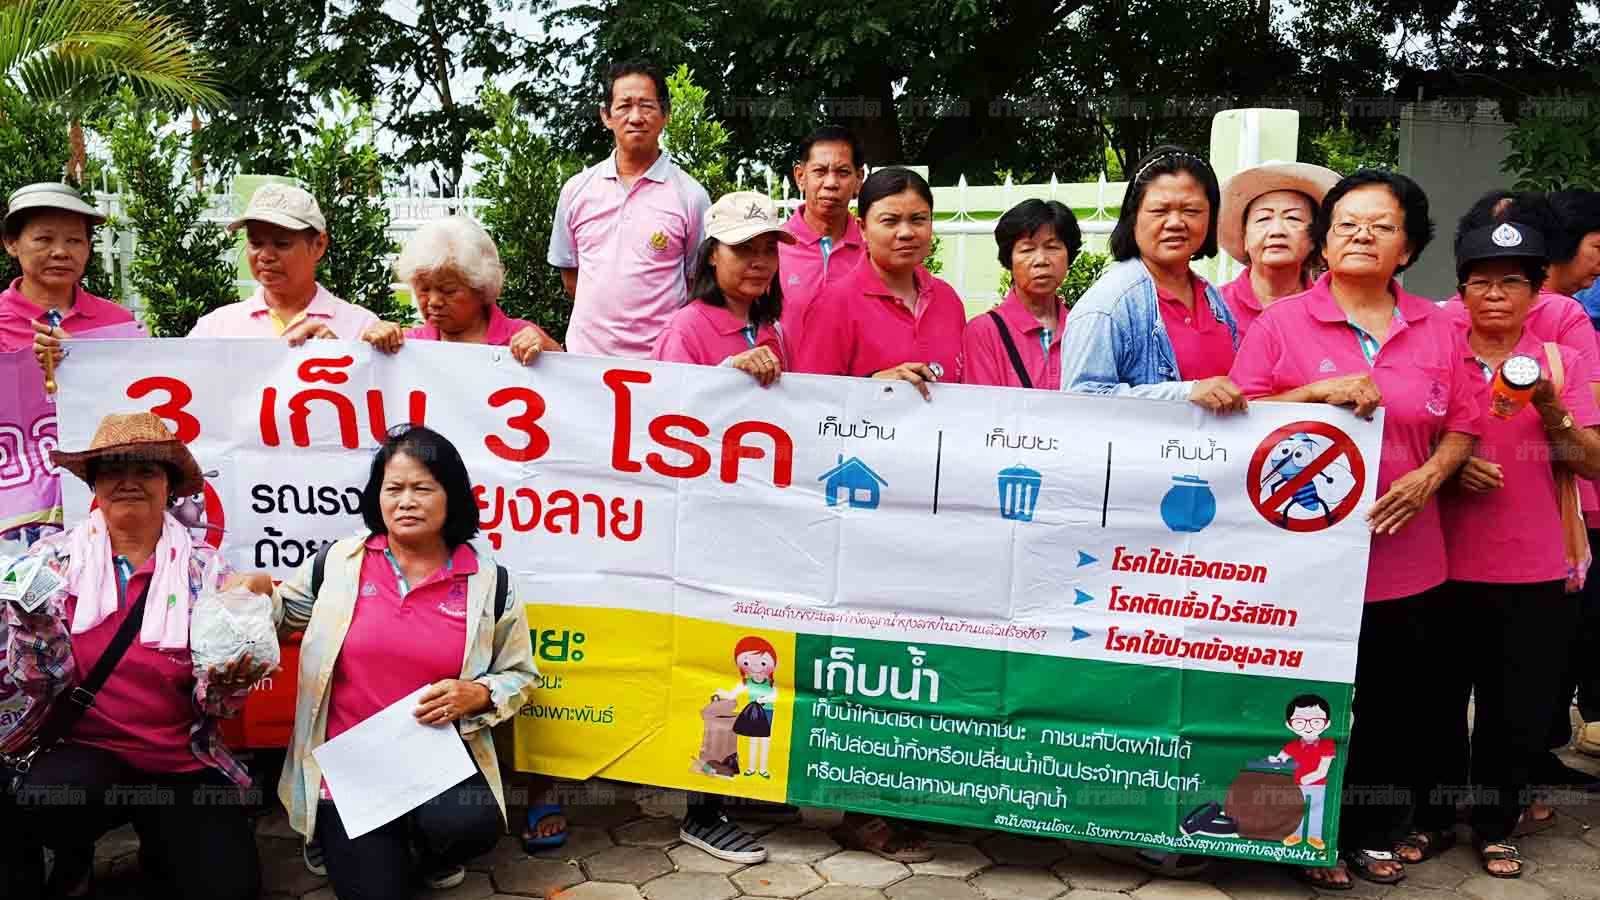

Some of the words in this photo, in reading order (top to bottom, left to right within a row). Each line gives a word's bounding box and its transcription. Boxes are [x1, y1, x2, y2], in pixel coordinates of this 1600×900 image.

[259, 355, 427, 449] เก็บ
[484, 387, 550, 461] 3
[603, 369, 793, 487] โรค
[818, 416, 895, 440] เก็บบ้าน
[985, 428, 1059, 451] เก็บขยะ
[1160, 437, 1227, 462] เก็บน้ำ
[473, 485, 643, 549] ยุงลาย
[1111, 546, 1267, 583] โรคไข้เลือดออก
[1107, 586, 1298, 627] โรคติดเชื้อไวรัสซิกา
[1105, 626, 1304, 669] โรคไข้ปวดข้อยุงลาย
[813, 646, 939, 704] เก็บน้ำ
[812, 698, 923, 729] เก็บน้ำให้มิดชิด
[930, 714, 1026, 741] ปิดฝาภาชนะ
[1040, 728, 1192, 760] ภาชนะที่ปิดฝาไม่ได้
[807, 761, 1067, 810] หรือปล่อยปลาหางนกยูงกินลูกน้ำ
